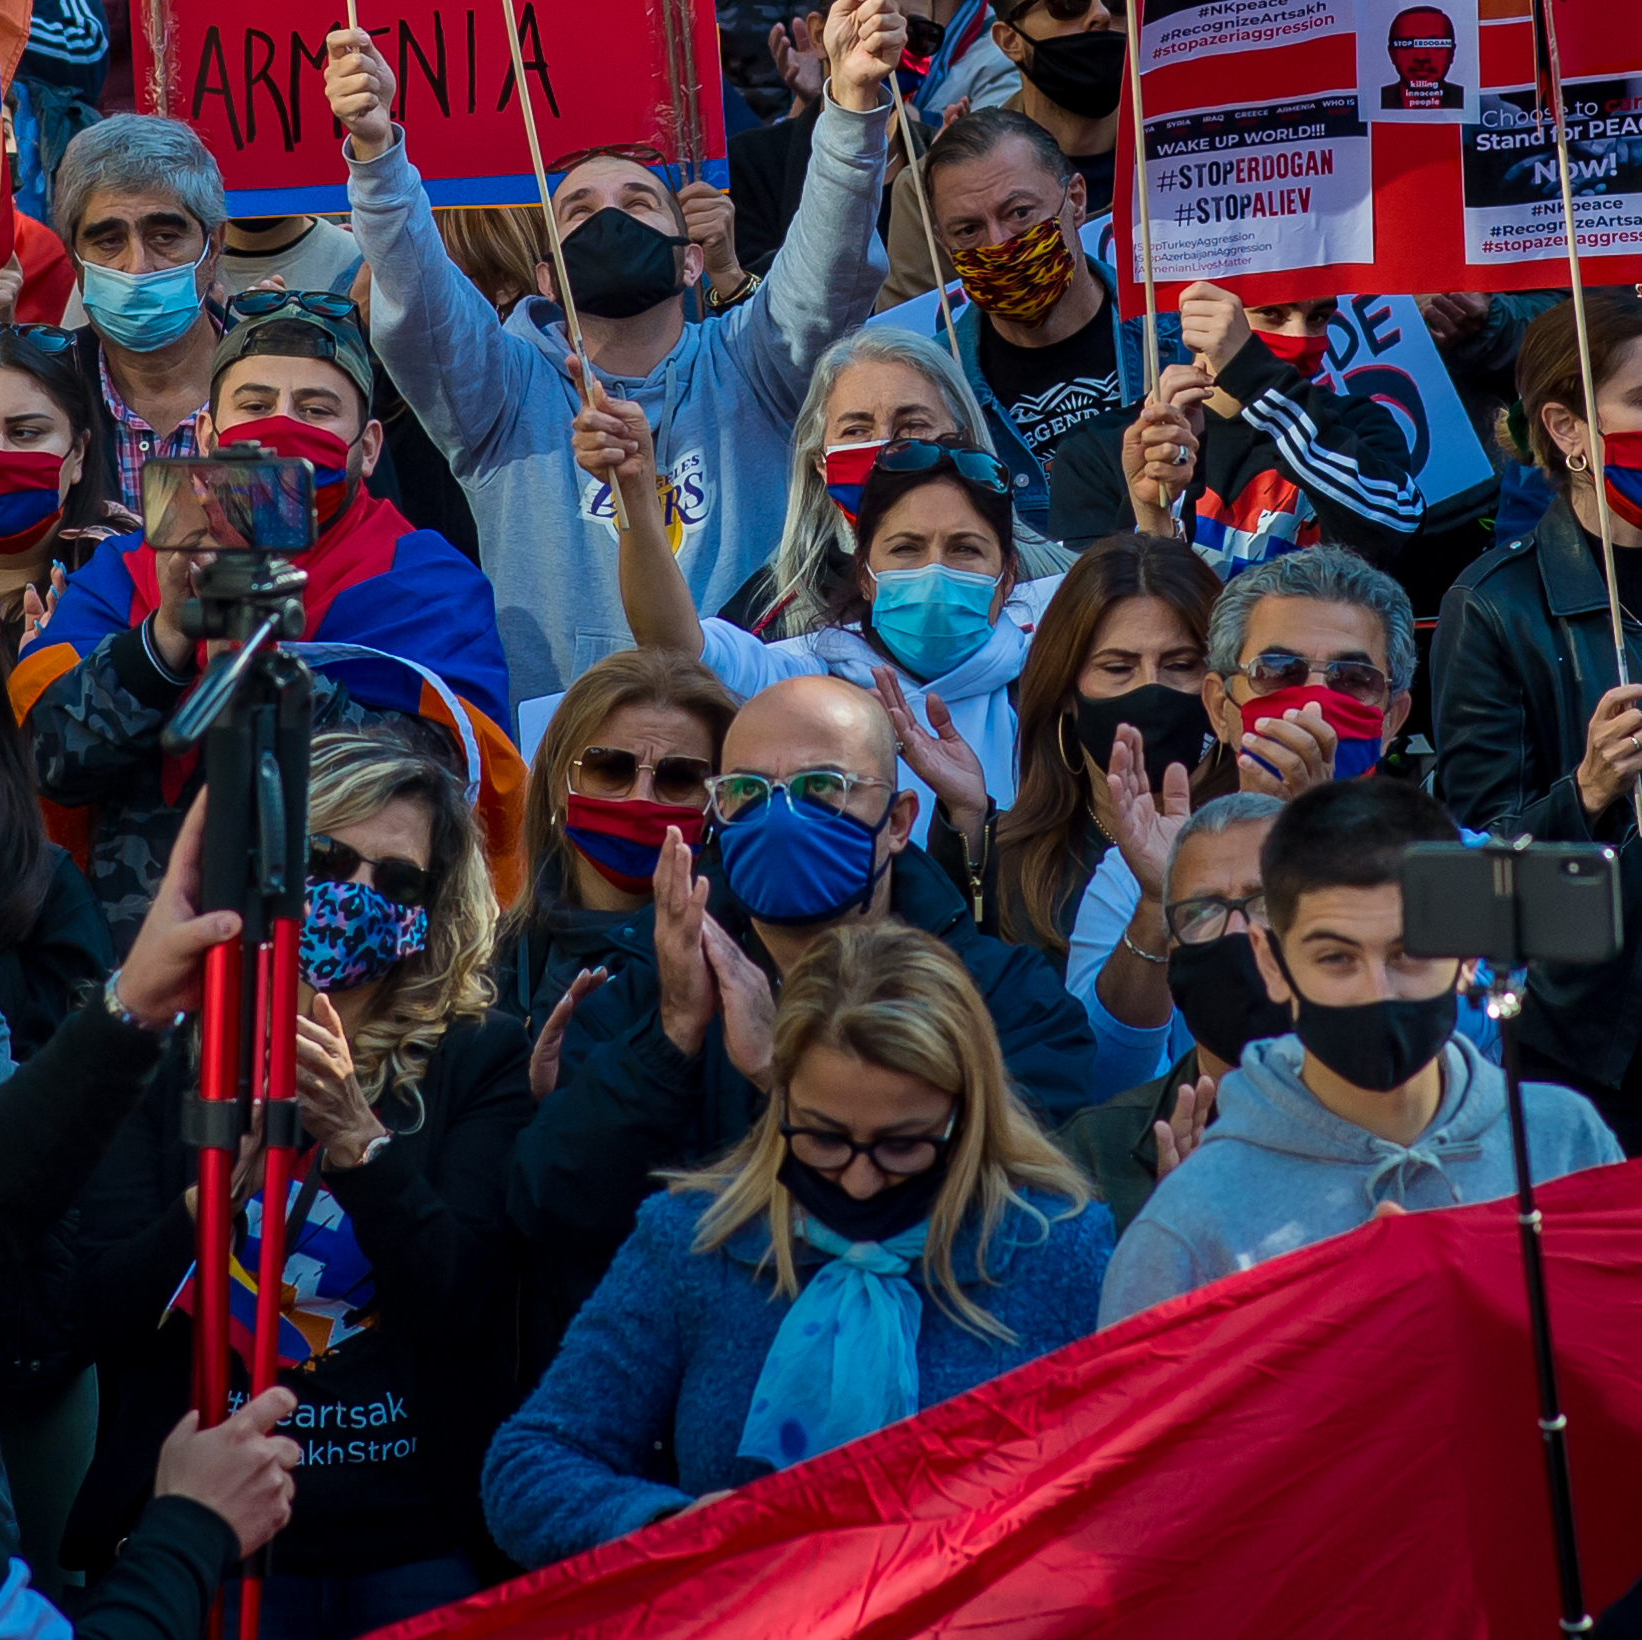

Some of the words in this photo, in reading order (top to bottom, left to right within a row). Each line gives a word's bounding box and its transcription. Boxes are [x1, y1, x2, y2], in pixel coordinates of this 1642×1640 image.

[1160, 1, 1327, 44] #RecognizeArtsakh
[1152, 13, 1335, 60] #stopazeriaggression
[1405, 89, 1444, 98] innocent
[1410, 80, 1439, 90] killing
[1166, 118, 1192, 129] SYRIA
[1202, 114, 1225, 123] IRAQ
[1234, 109, 1269, 119] GREECE
[1276, 103, 1316, 114] ARMENIA
[1322, 99, 1345, 107] WHO
[1347, 98, 1355, 106] IS
[1409, 97, 1440, 108] people
[1575, 101, 1599, 117] to
[1157, 138, 1210, 157] WAKE
[1215, 134, 1240, 149] UP
[1244, 123, 1326, 145] WORLD!!!
[1476, 125, 1544, 152] Stand
[1156, 148, 1334, 193] #STOPERDOGAN
[1173, 186, 1312, 228] #STOPALIEV
[1134, 231, 1256, 252] #SopTurkeyAggression
[1134, 255, 1252, 275] #AmenianLivesMatter
